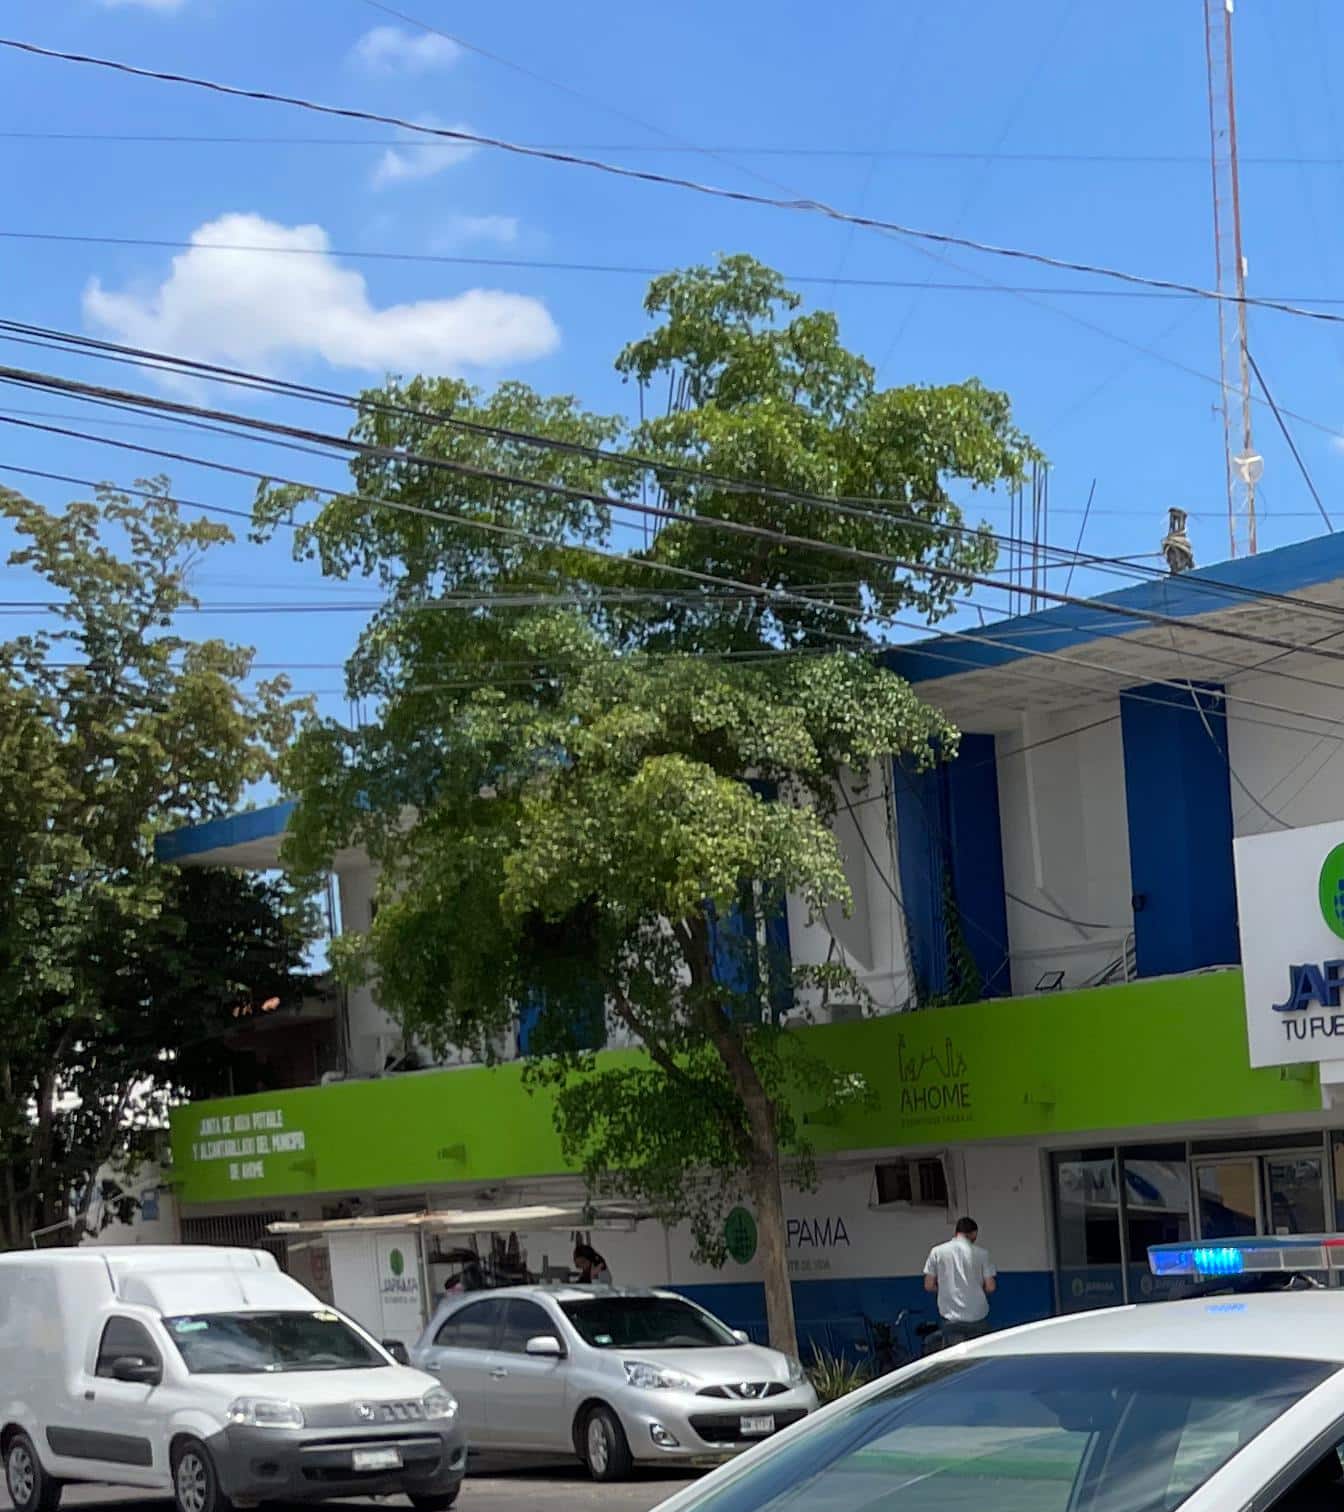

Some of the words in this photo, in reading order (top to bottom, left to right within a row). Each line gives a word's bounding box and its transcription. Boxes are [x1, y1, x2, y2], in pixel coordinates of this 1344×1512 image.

[1282, 1018, 1306, 1040] TU
[901, 1083, 971, 1113] AHOME
[786, 1217, 850, 1248] PAMA
